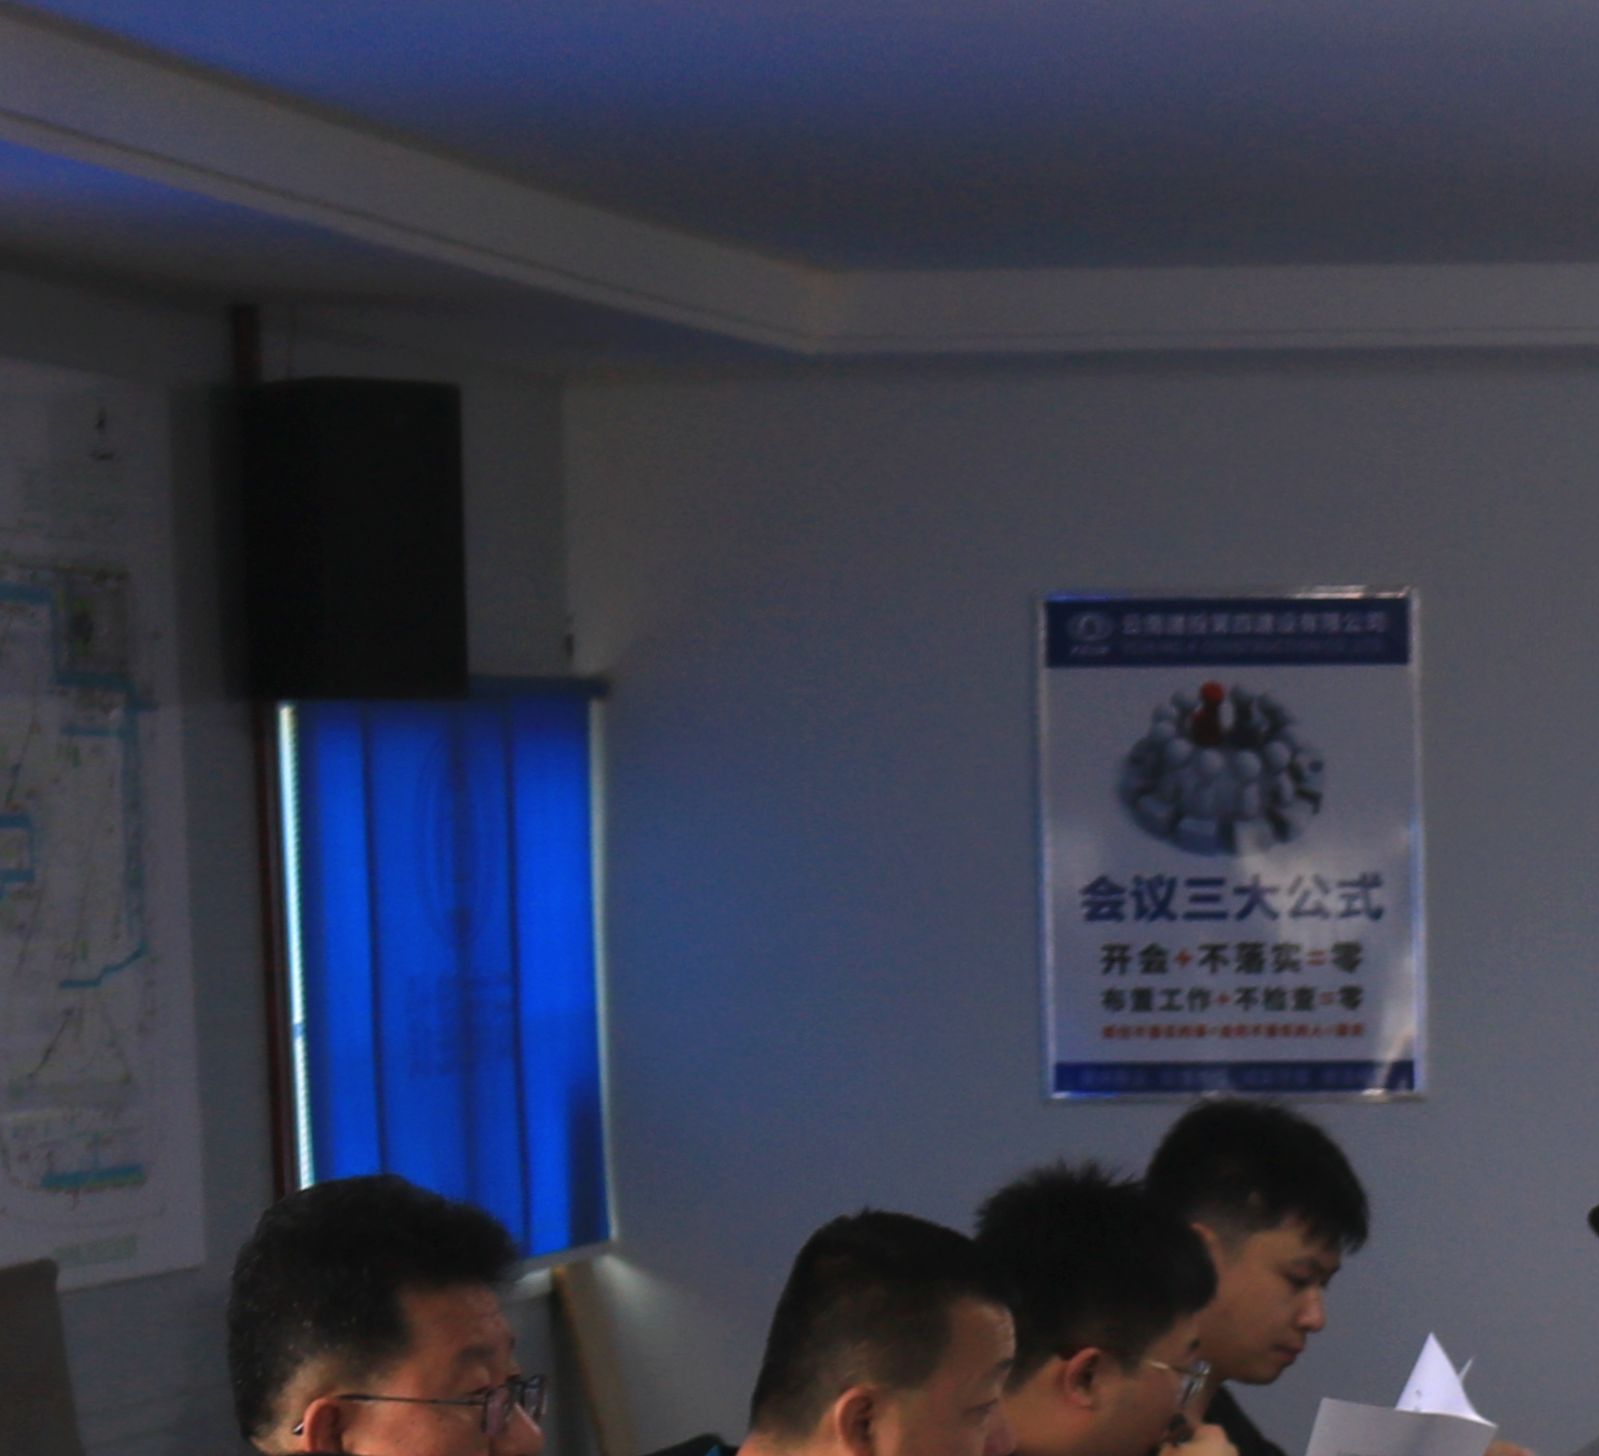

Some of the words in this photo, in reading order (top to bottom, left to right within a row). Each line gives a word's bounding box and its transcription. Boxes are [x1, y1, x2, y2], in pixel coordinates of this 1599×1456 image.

[1081, 874, 1384, 923] 会议三大公式
